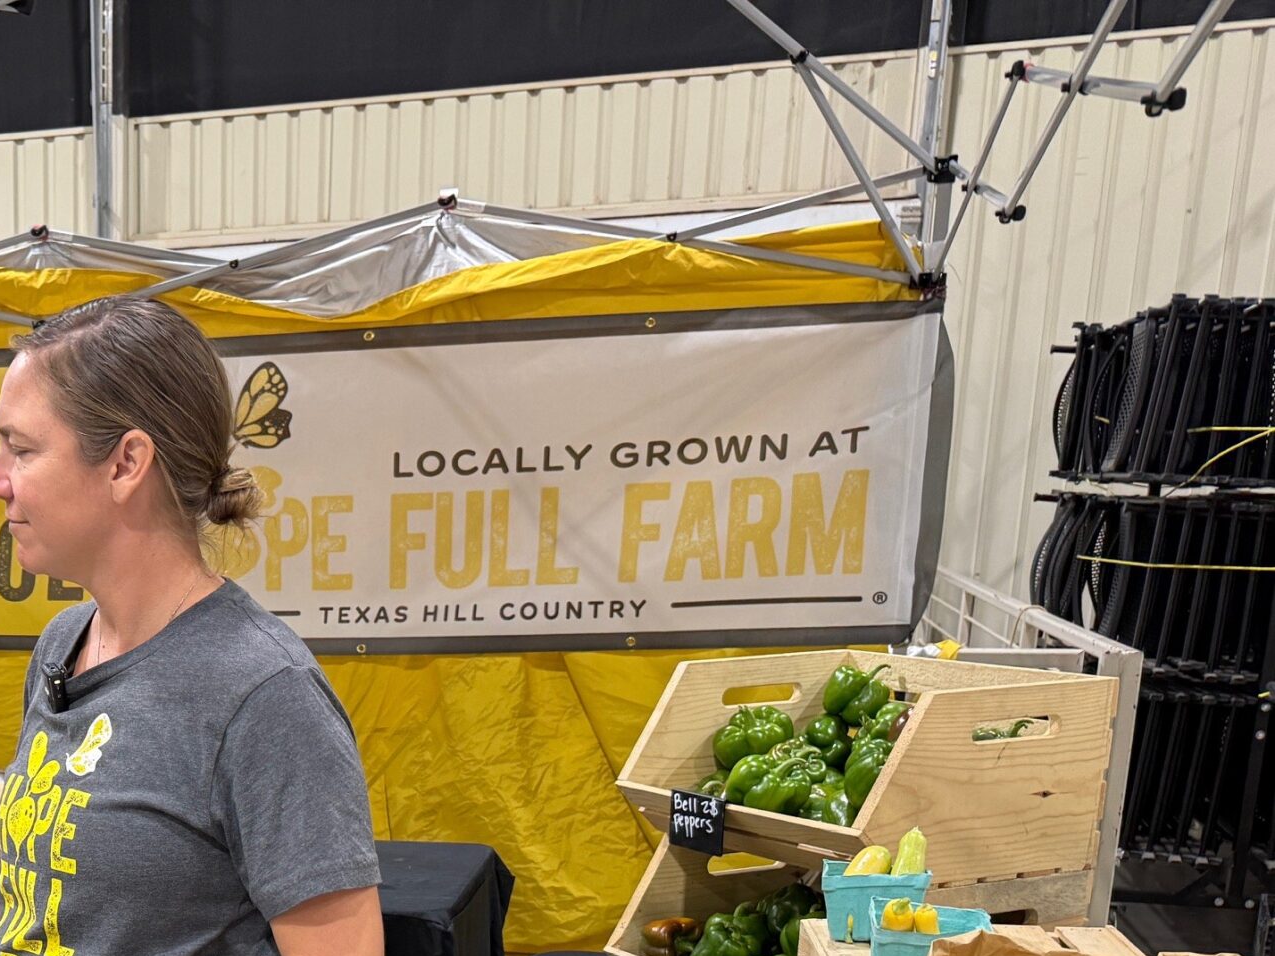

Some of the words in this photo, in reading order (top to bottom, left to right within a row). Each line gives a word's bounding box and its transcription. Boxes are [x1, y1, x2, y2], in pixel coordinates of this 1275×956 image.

[392, 443, 593, 479] LOCALLY
[609, 432, 789, 469] GROWN
[809, 425, 870, 458] AT
[389, 486, 580, 590] FULL
[618, 469, 870, 583] FARM
[318, 605, 408, 625] TEXAS
[422, 603, 485, 623] HILL
[498, 600, 647, 622] COUNTRY
[673, 793, 698, 814] Bell
